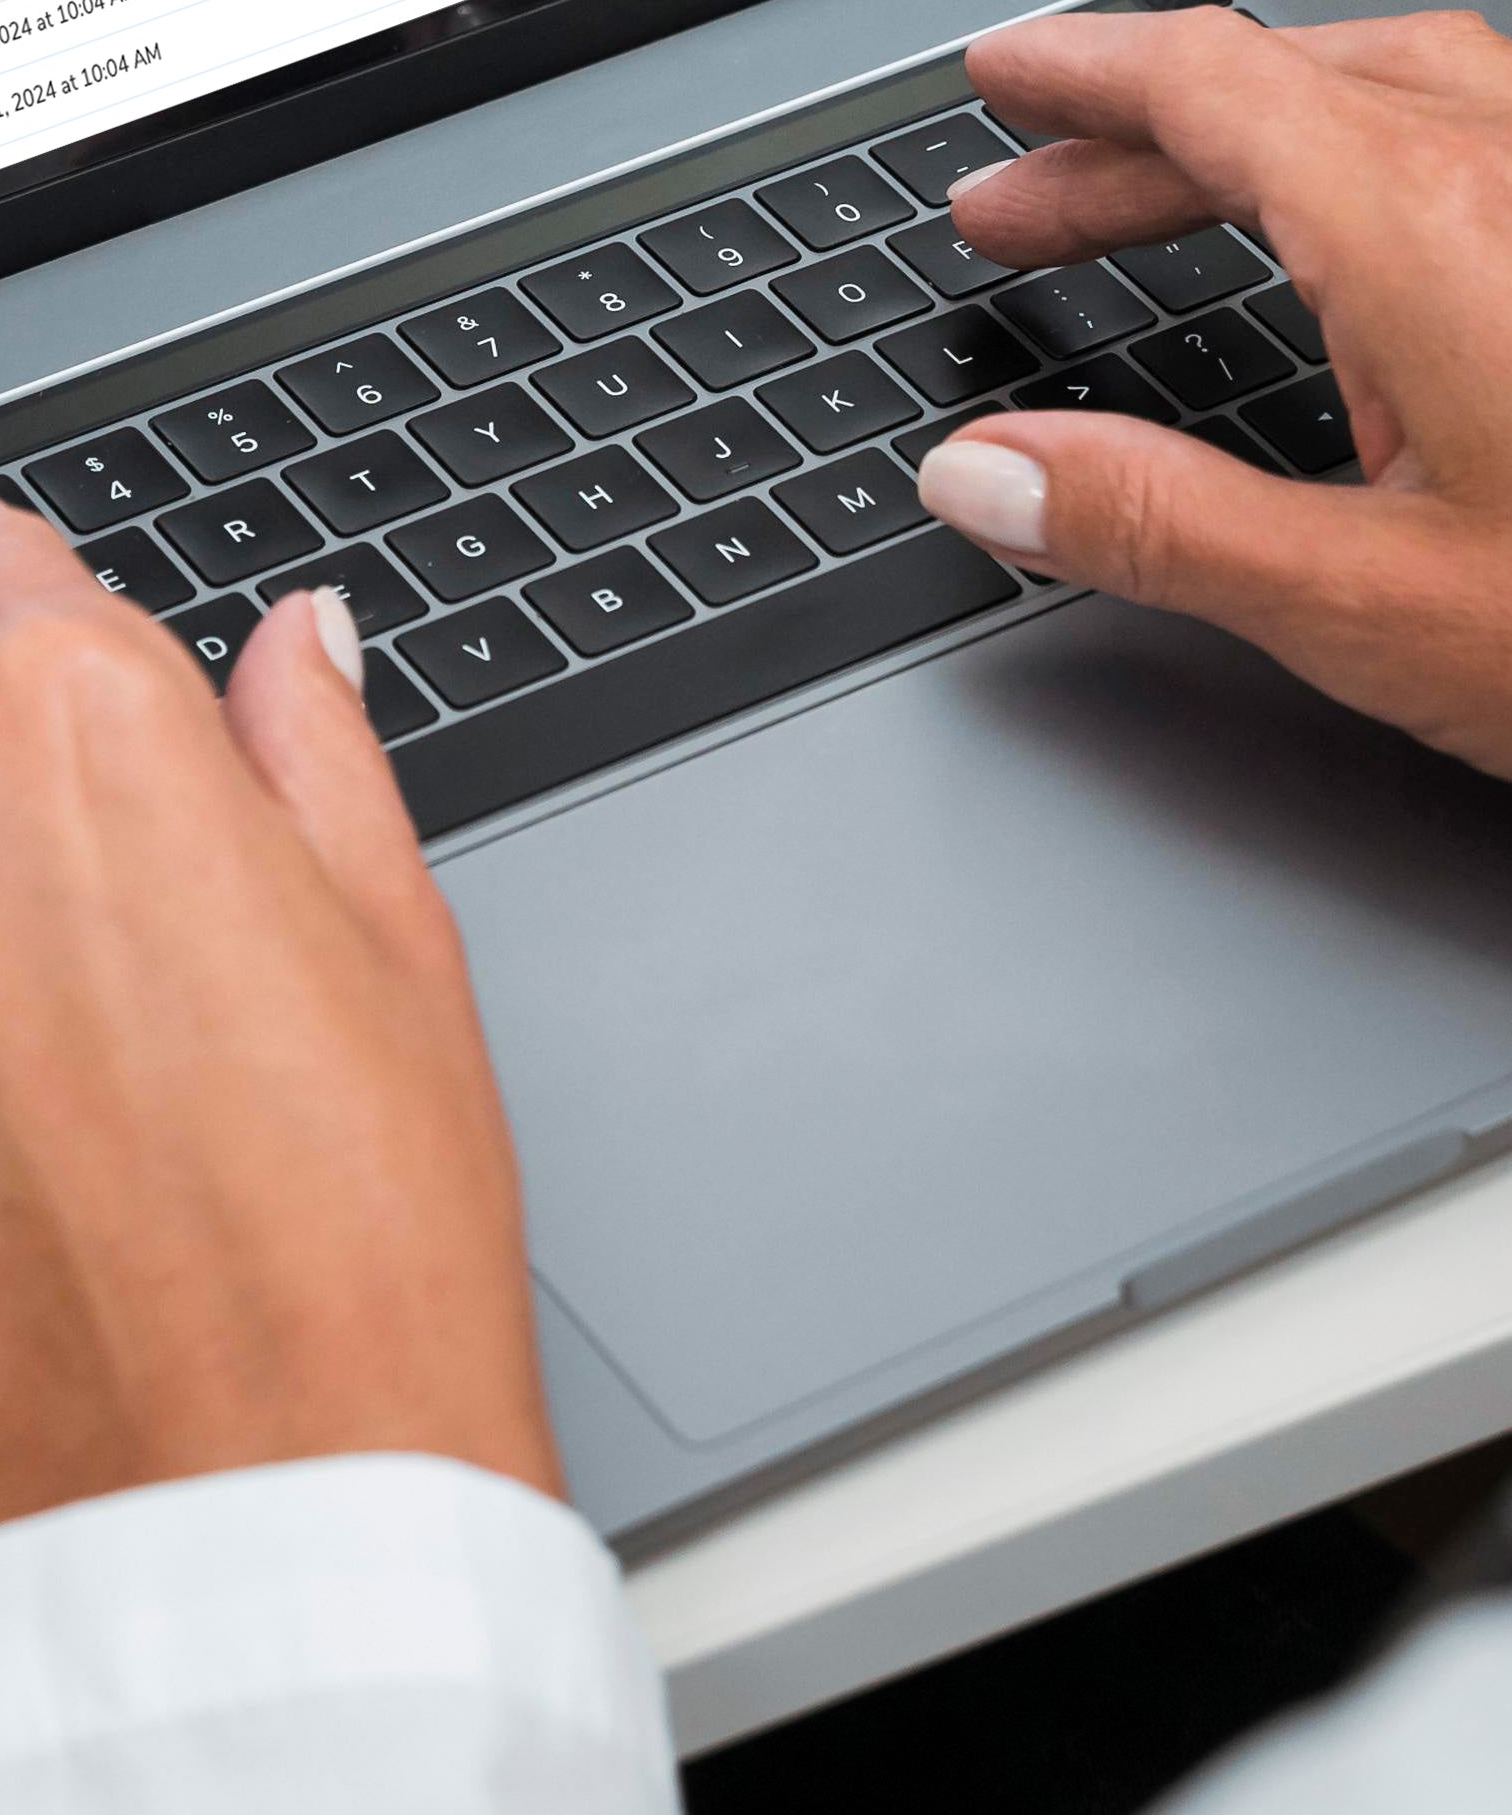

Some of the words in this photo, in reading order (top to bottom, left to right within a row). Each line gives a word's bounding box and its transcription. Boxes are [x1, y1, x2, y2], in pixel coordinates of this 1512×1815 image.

[37, 12, 53, 30] at
[11, 81, 56, 111] 2024
[61, 75, 78, 93] at
[82, 55, 129, 86] 10:04
[135, 43, 161, 68] AM
[718, 248, 743, 266] 9
[600, 293, 625, 311] 8
[477, 337, 497, 357] 7
[943, 348, 972, 364] L
[357, 385, 382, 404] 6
[597, 375, 627, 395] U
[822, 390, 854, 412] K
[231, 432, 258, 452] 5
[474, 422, 499, 442] Y
[715, 437, 731, 458] J
[111, 481, 131, 499] 4
[350, 470, 375, 490] T
[579, 485, 613, 509] H
[838, 488, 876, 513] M
[224, 520, 255, 542] R
[457, 536, 485, 557] G
[716, 538, 750, 562] N
[96, 568, 127, 593] E
[592, 589, 623, 612] B
[197, 637, 227, 660] D
[463, 638, 490, 661] V
